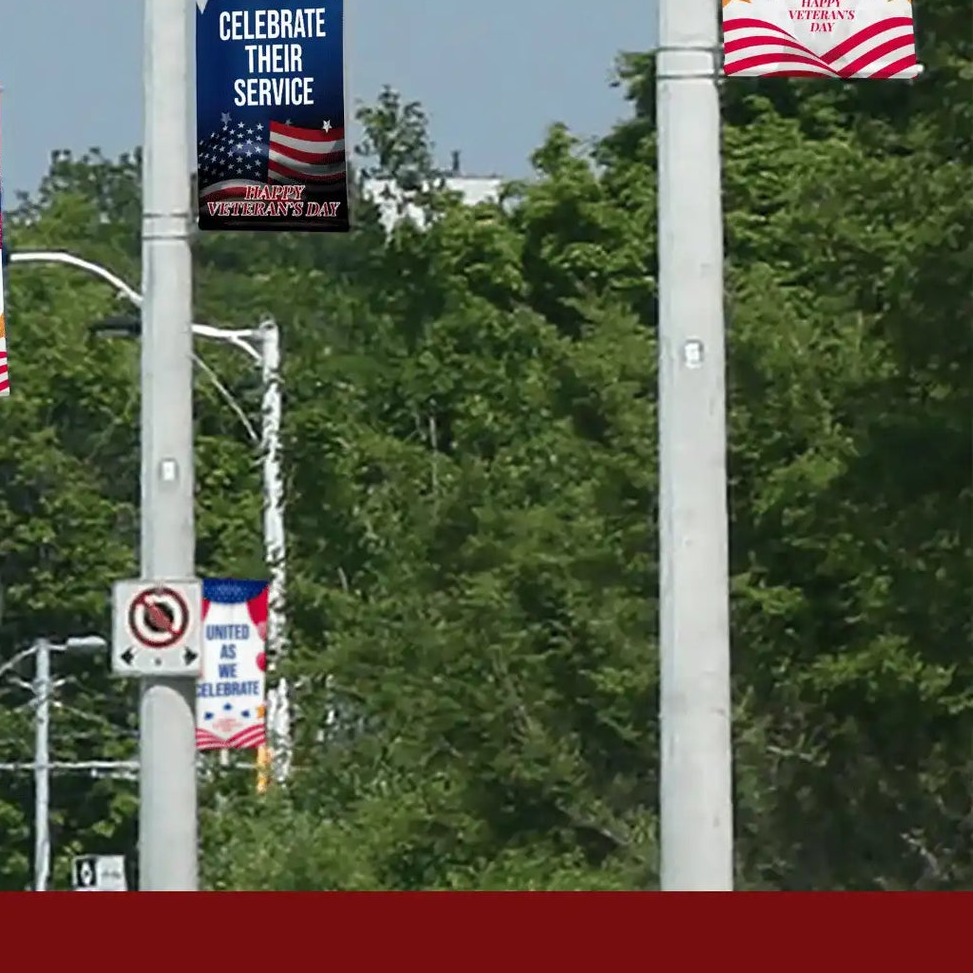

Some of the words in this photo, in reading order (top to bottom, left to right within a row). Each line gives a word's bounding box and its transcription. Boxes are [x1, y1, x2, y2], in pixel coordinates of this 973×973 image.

[788, 9, 856, 20] VETERAN'S
[219, 7, 326, 41] CELEBRATE
[810, 22, 836, 33] DAY
[244, 43, 303, 74] THEIR
[234, 77, 315, 107] SERVICE
[244, 184, 306, 201] HAPPY
[207, 201, 304, 217] VETERAN'S
[305, 201, 341, 217] DAY
[205, 623, 250, 641] UNITED
[220, 643, 237, 660] AS
[217, 663, 237, 679] WE
